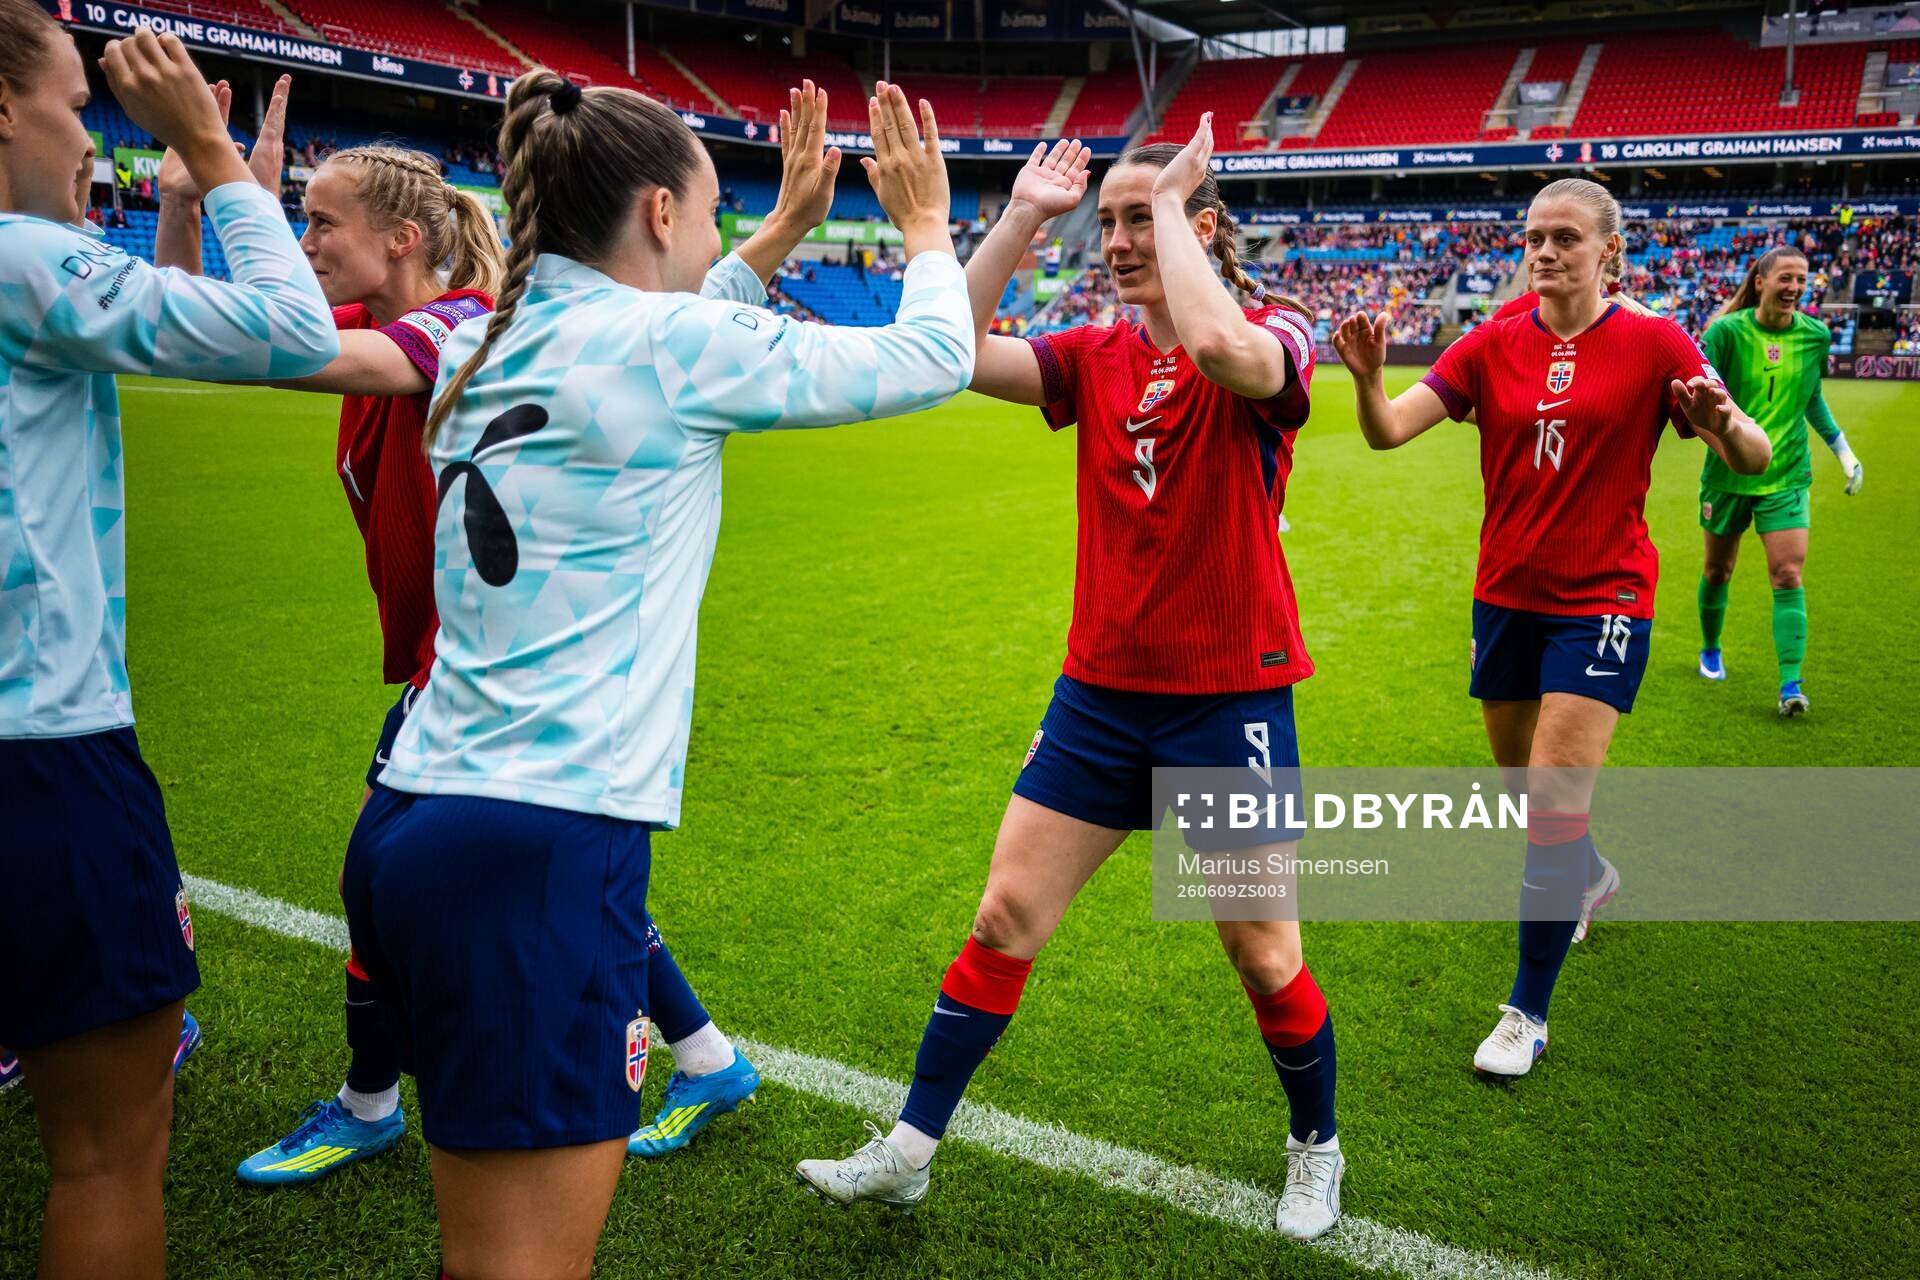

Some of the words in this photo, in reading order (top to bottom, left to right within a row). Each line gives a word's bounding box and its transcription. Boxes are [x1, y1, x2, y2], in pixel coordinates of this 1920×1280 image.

[85, 3, 106, 22] 10
[113, 9, 204, 41] CAROLINE
[206, 26, 277, 54] GRAHAM
[279, 41, 342, 66] HANSEN
[1601, 145, 1617, 158] 10
[1622, 141, 1699, 158] CAROLINE
[1701, 138, 1771, 155] GRAHAM
[1773, 136, 1842, 153] HANSEN
[1876, 136, 1904, 147] Norsk
[1225, 155, 1287, 171] CAROLINE
[1288, 153, 1343, 169] GRAHAM
[1343, 152, 1399, 167] HANSEN
[1848, 204, 1867, 213] orsk
[1132, 438, 1157, 501] 9
[1244, 722, 1273, 788] 9
